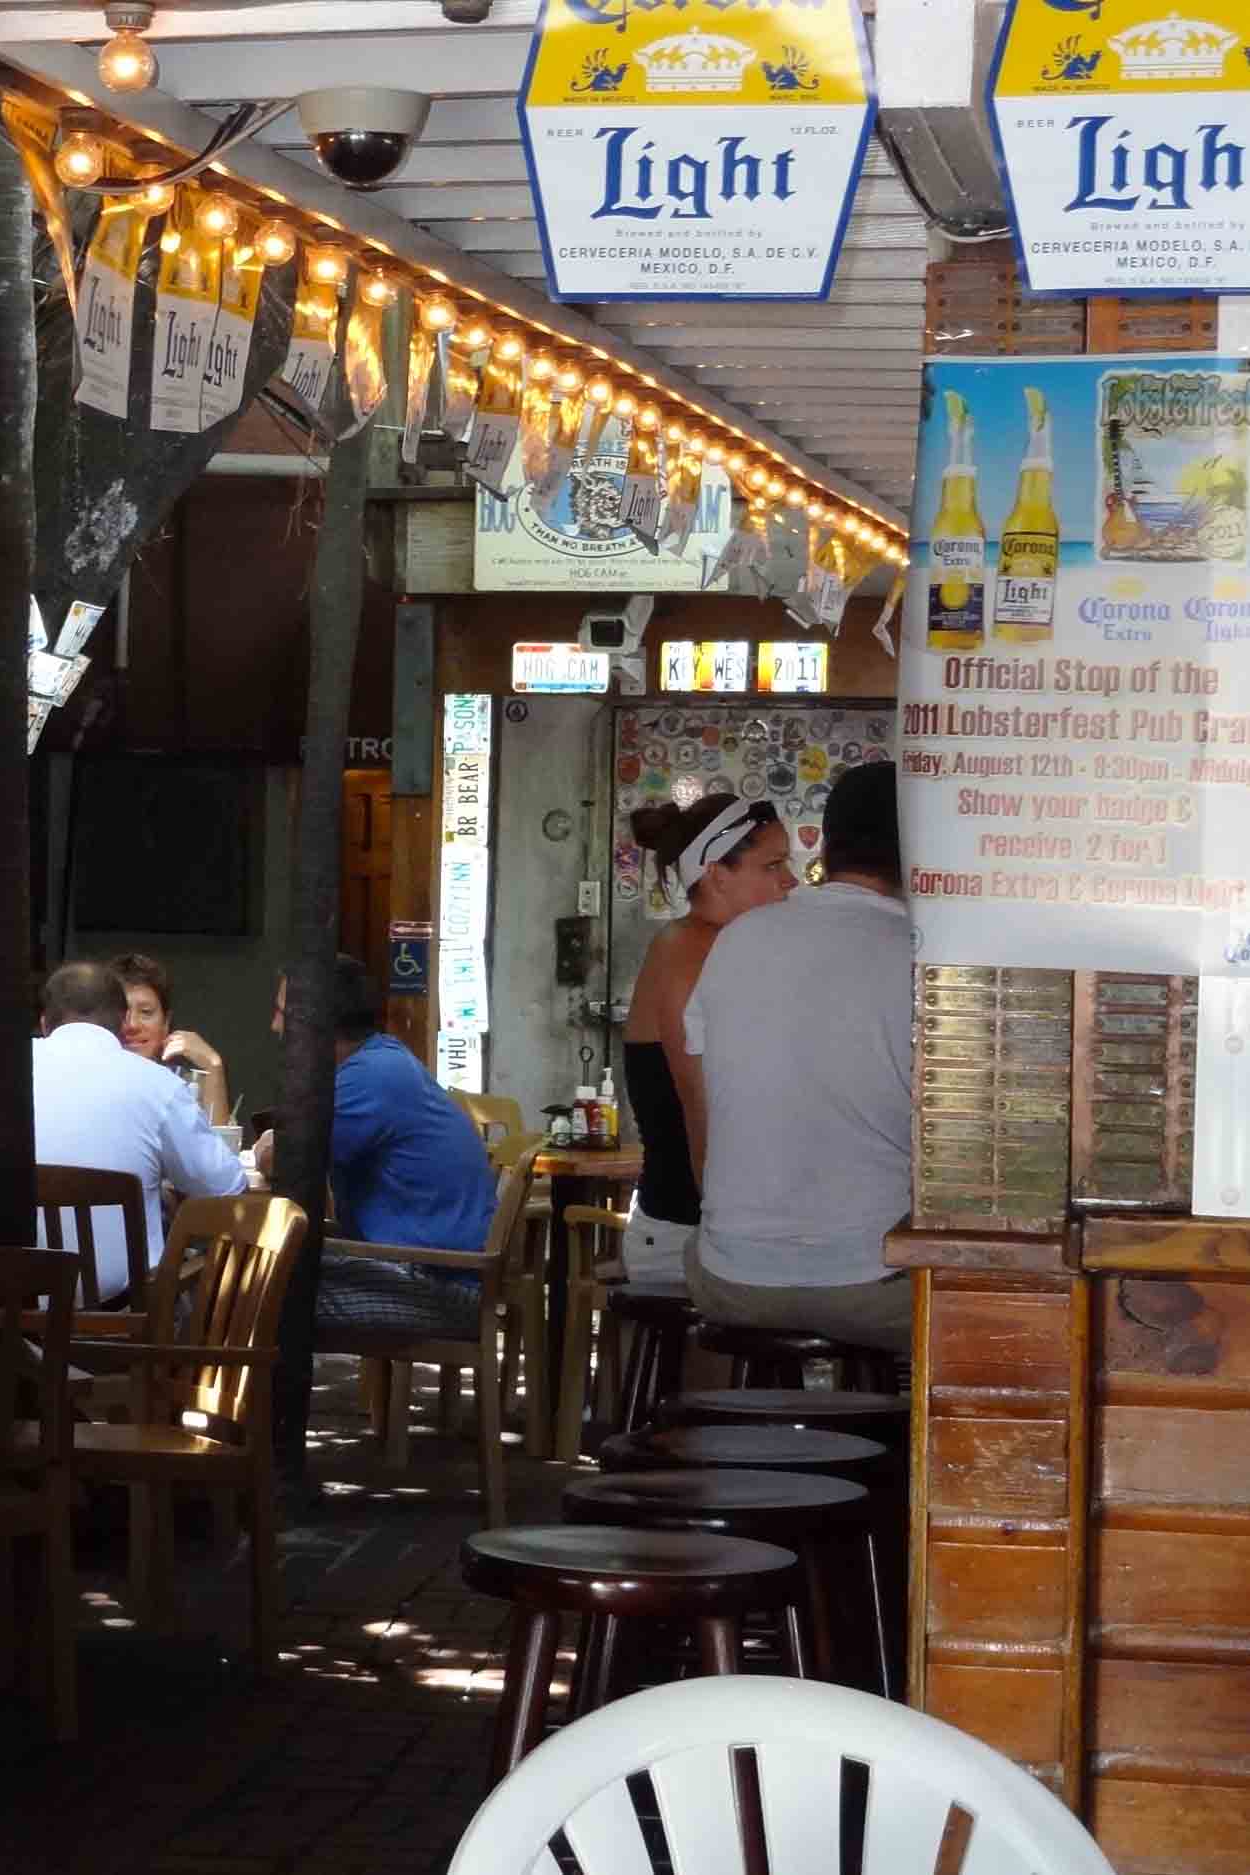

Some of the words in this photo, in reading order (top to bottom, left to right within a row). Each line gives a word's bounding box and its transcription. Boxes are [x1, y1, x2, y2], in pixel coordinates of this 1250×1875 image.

[547, 128, 583, 137] BEER
[1017, 119, 1055, 128] BEER
[590, 127, 797, 219] Light
[1062, 116, 1250, 213] Ligh
[615, 229, 662, 238] Brewed
[667, 229, 689, 238] and
[695, 229, 744, 238] bottled
[749, 229, 763, 239] by
[1090, 222, 1138, 231] Brewed
[1145, 221, 1169, 231] and
[1176, 221, 1224, 231] bottled
[1230, 221, 1245, 232] by
[559, 247, 653, 258] CERVECERIA
[659, 247, 726, 260] MODELO,
[732, 247, 759, 258] S.A.
[766, 247, 786, 258] DE
[792, 247, 817, 258] C.V.
[1031, 240, 1129, 254] CERVECERIA
[1136, 239, 1206, 252] MODELO,
[1213, 239, 1244, 251] S.A.
[640, 263, 702, 277] MEXICO,
[709, 263, 735, 275] D.F.
[1116, 256, 1182, 270] MEXICO,
[1189, 256, 1217, 268] D.F.
[161, 311, 201, 378] Ligh
[532, 521, 559, 545] THAN
[561, 538, 578, 550] NO
[581, 540, 630, 552] BREATH
[569, 568, 593, 578] HOG
[595, 567, 617, 578] CAM
[1078, 598, 1170, 624] Corona
[1182, 597, 1250, 621] Coron
[1103, 622, 1152, 642] Extra
[566, 658, 599, 681] CAM
[669, 657, 700, 681] KEY
[714, 657, 746, 681] WES
[773, 657, 819, 681] 2011
[944, 656, 1044, 690] Official
[1053, 659, 1120, 698] Stop
[1130, 660, 1161, 694] of
[1171, 662, 1219, 695] the
[902, 703, 938, 736] 2011
[946, 703, 1120, 741] Lobsterfest
[1130, 709, 1183, 741] Pub
[1193, 711, 1250, 744] Cra
[952, 752, 1023, 777] August
[1031, 753, 1073, 776] 12th
[458, 761, 479, 813] BEAR
[958, 786, 1022, 817] Show
[1032, 793, 1088, 822] your
[458, 814, 479, 837] BR
[979, 832, 1071, 858] receive
[1085, 834, 1101, 861] 2
[1108, 834, 1149, 863] for
[910, 867, 982, 897] Corona
[990, 871, 1060, 898] Extra
